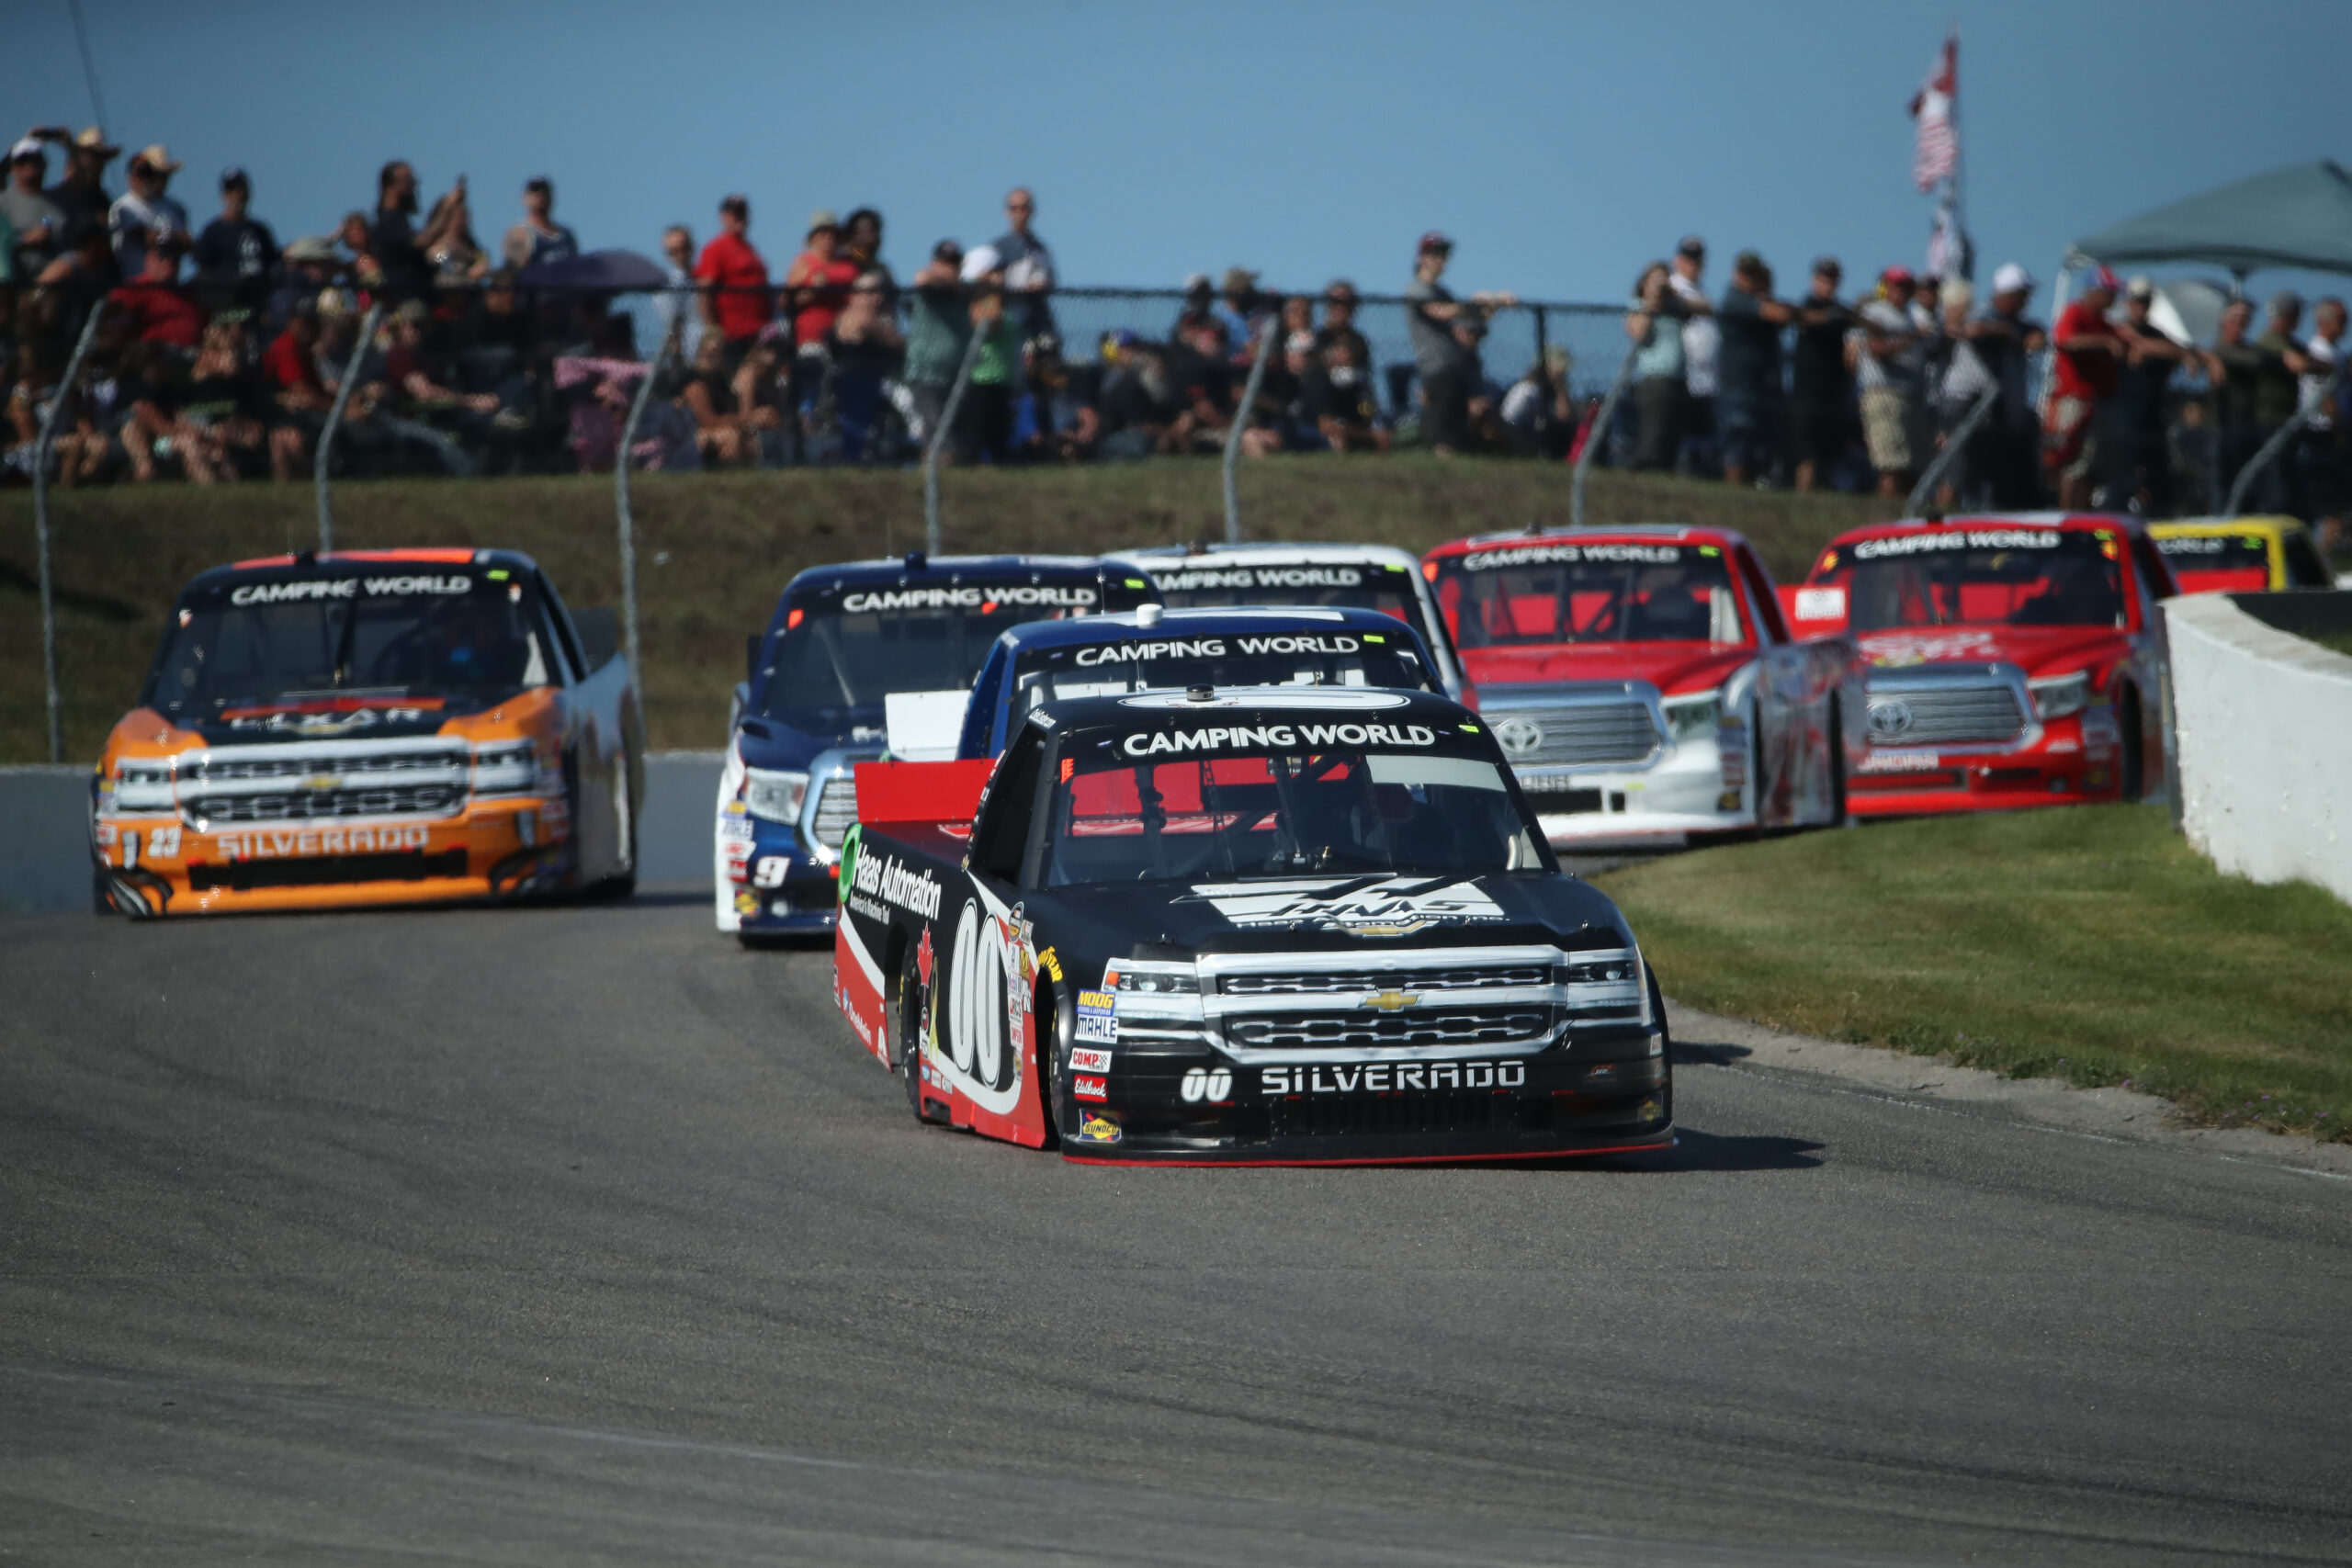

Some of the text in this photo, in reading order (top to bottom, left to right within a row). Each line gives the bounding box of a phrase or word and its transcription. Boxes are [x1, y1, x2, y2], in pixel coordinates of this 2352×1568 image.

[1463, 544, 1679, 571] CAMPING WORLD
[1855, 530, 2061, 558] CAMPING WORLD
[232, 576, 472, 605] CAMPING WORLD
[1154, 569, 1362, 591] AMPING WORLD
[842, 587, 1096, 612] CAMPING WORLD
[1076, 637, 1360, 666] CAMPING WORLD
[1124, 724, 1435, 756] CAMPING WORLD
[217, 826, 429, 857] SILVERADO
[752, 855, 791, 888] 9
[852, 841, 942, 920] Haas Automation
[949, 898, 1001, 1090] 00
[1078, 990, 1115, 1009] MOOG
[1077, 1017, 1117, 1038] MAHLE
[1073, 1050, 1099, 1066] COMP
[1074, 1078, 1107, 1098] Edelbrock
[1181, 1066, 1233, 1102] 00
[1261, 1060, 1525, 1094] SILVERADO
[1084, 1122, 1118, 1134] SUNOCO
